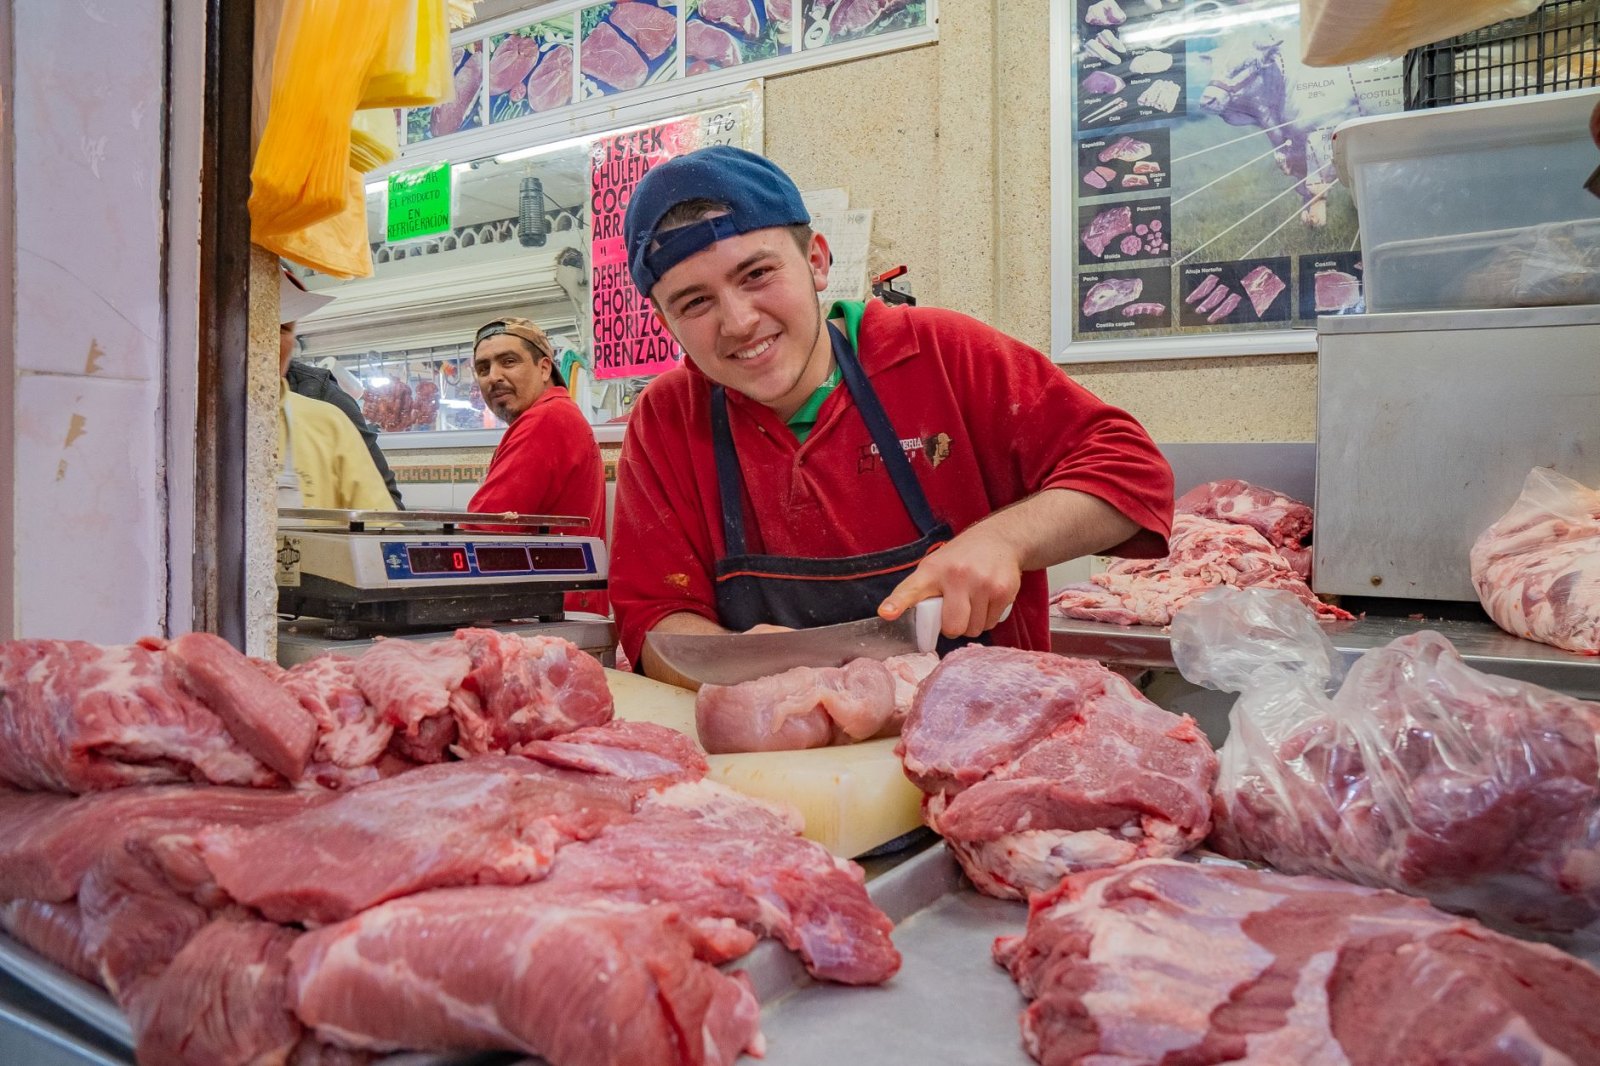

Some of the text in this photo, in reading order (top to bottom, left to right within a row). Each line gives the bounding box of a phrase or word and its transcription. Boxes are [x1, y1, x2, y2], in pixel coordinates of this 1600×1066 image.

[1296, 79, 1335, 91] ESPALDA
[1360, 87, 1402, 100] COSTILL
[592, 156, 650, 190] CHULETA
[592, 183, 639, 216] COC
[408, 208, 421, 220] EN
[592, 213, 624, 241] ARR
[593, 261, 634, 292] DESHE
[594, 336, 684, 370] PRENZADO
[452, 552, 464, 569] 0
